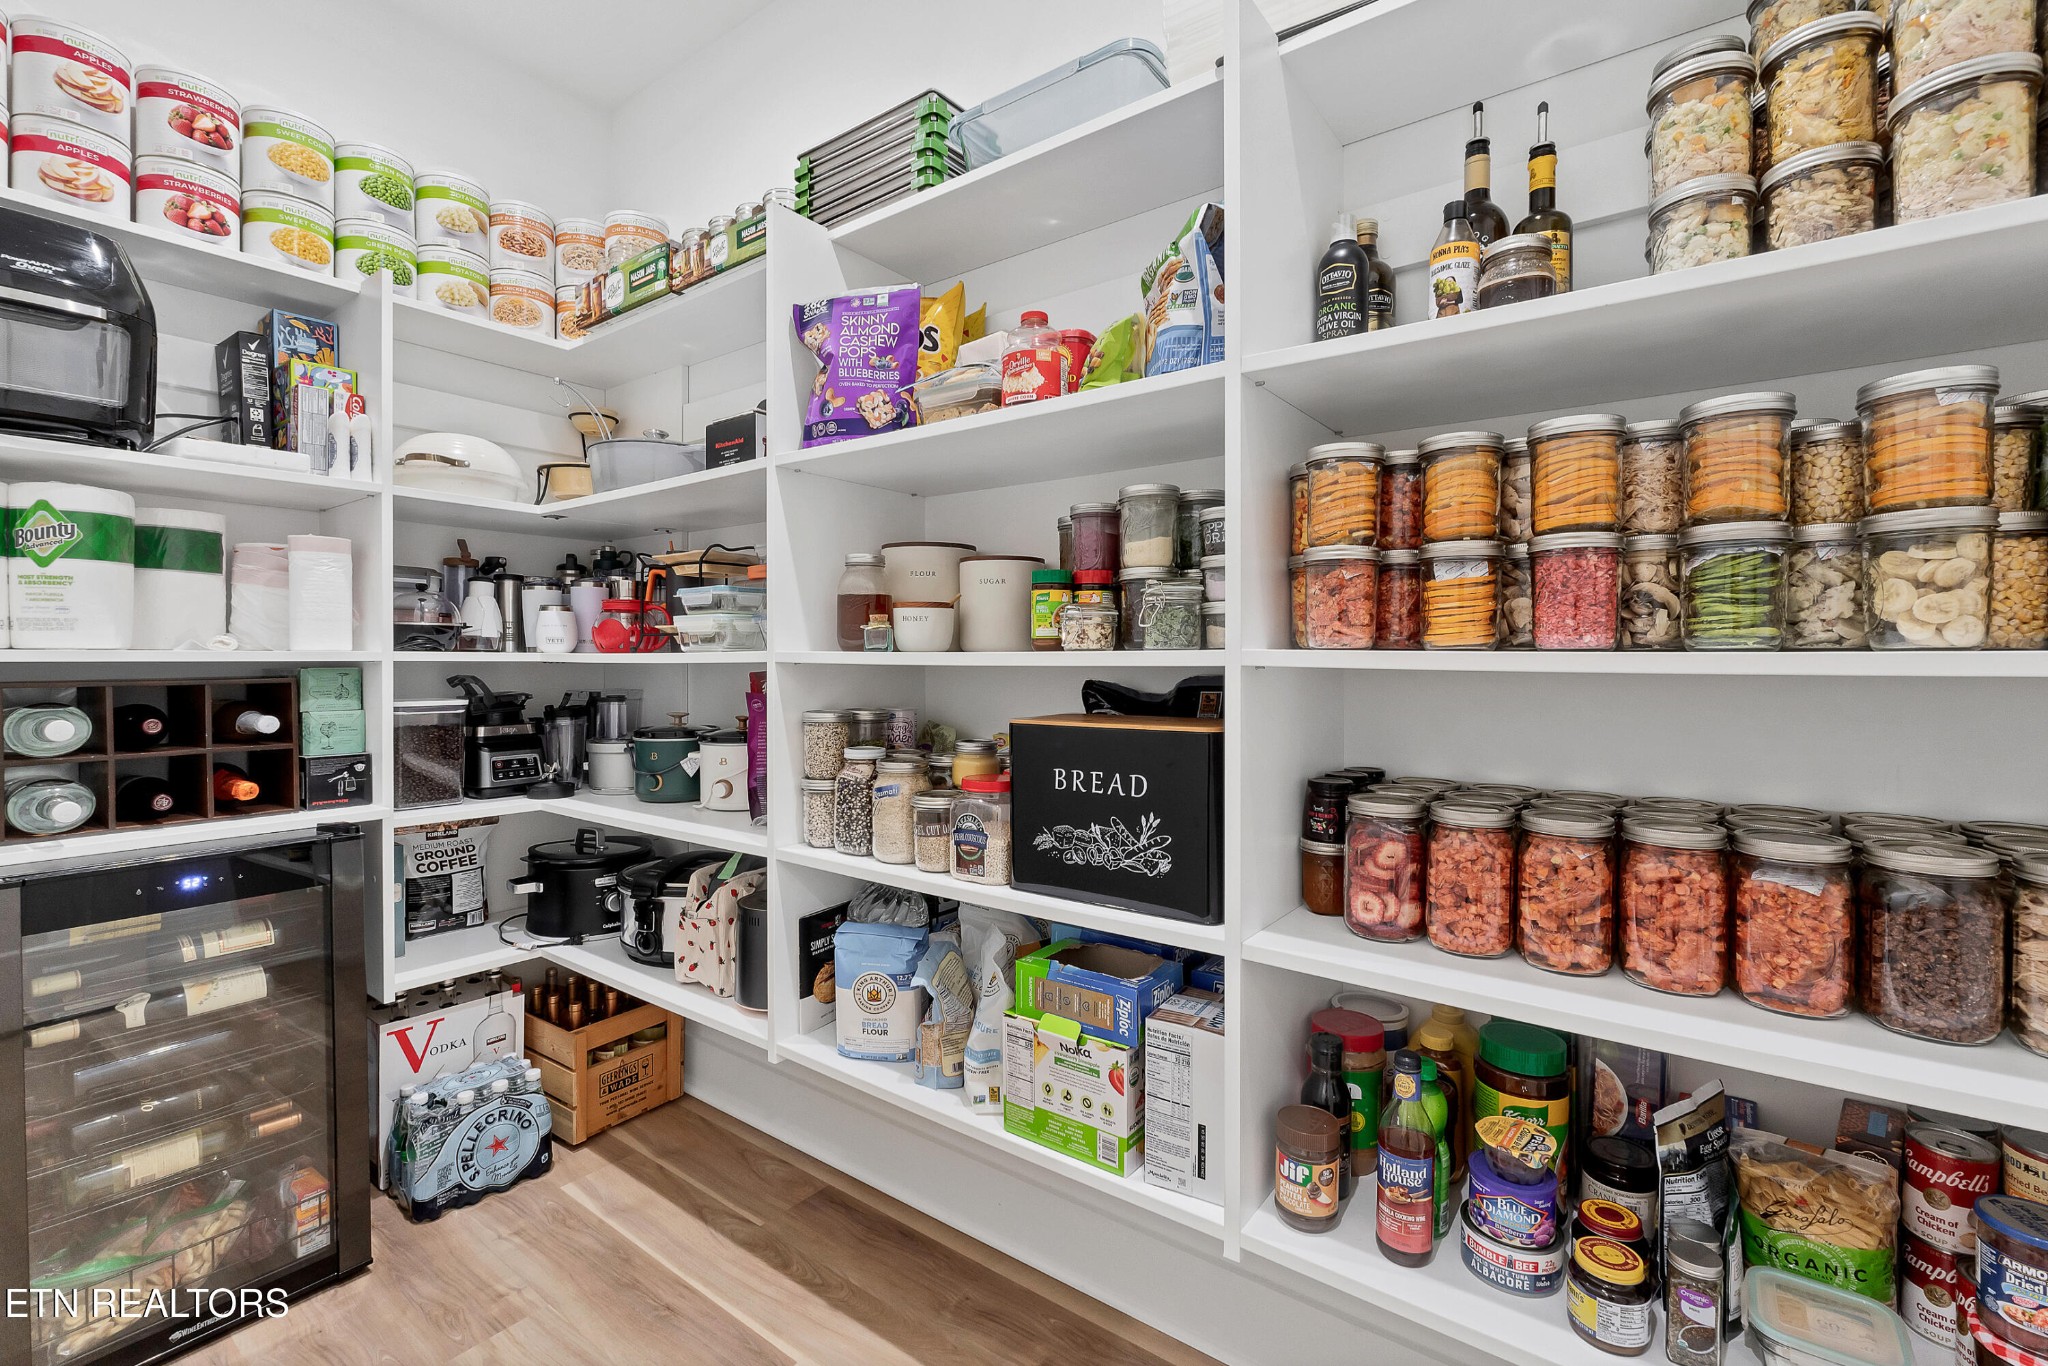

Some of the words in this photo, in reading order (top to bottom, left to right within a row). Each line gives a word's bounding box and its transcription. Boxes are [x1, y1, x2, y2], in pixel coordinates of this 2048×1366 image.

[74, 50, 113, 72] APPLES
[168, 88, 235, 120] STRAWBERRIES
[49, 131, 109, 156] nutristore
[276, 128, 306, 142] SWEET
[57, 143, 100, 161] APPLES
[175, 170, 225, 194] nutristore
[163, 179, 233, 207] STRAWBERRIES
[278, 213, 308, 227] SWEET
[1321, 269, 1353, 285] OTTAVIO
[1318, 301, 1357, 318] ORGANIC
[1333, 311, 1362, 321] VIRGIN
[841, 312, 888, 326] SKINNY
[1318, 320, 1339, 335] OLIVE
[1340, 319, 1356, 329] OIL
[839, 322, 900, 336] ALMOND
[1321, 328, 1349, 341] SPRAY
[838, 333, 899, 348] CASHEW
[241, 348, 267, 359] Degree
[838, 346, 877, 359] POPS
[838, 357, 863, 367] WITH
[1008, 356, 1031, 370] Orville
[838, 368, 900, 380] BLUEBERRIES
[14, 522, 77, 548] Bounty
[25, 538, 64, 550] Advanced
[1053, 767, 1148, 799] BREAD
[427, 830, 458, 838] KIRKLAND
[927, 825, 941, 836] CUT
[412, 842, 445, 851] MEDIUM
[446, 837, 474, 847] ROAST
[414, 844, 476, 862] GROUND
[415, 854, 478, 874] COFFEE
[182, 878, 201, 889] 52
[810, 937, 830, 952] SIMPLY
[856, 977, 869, 992] KING
[869, 976, 893, 994] ARTHUR
[1153, 982, 1175, 1007] Ziploc
[861, 1021, 889, 1029] BREAD
[1119, 997, 1132, 1039] Ziploc
[862, 1028, 889, 1036] FLOUR
[1147, 1027, 1168, 1037] Nutrition
[1147, 1032, 1160, 1041] Datos
[386, 1017, 467, 1074] VODKA
[1059, 1041, 1092, 1060] Noka
[609, 1074, 638, 1092] WADE
[1637, 1099, 1648, 1126] Barilla
[1279, 1157, 1311, 1184] Jif
[1379, 1153, 1427, 1179] Holland
[1904, 1148, 1990, 1194] Campbell's
[1279, 1179, 1304, 1194] PEANUT
[1382, 1168, 1423, 1188] House
[1665, 1175, 1696, 1186] Nutrition
[1279, 1187, 1302, 1201] BUTTER
[1279, 1194, 1310, 1211] CHOCOLATE
[1482, 1199, 1541, 1225] DIAMOND
[1497, 1197, 1528, 1216] BLUE
[1760, 1199, 1849, 1231] Garofalo
[1394, 1211, 1415, 1220] COOKING
[1493, 1217, 1532, 1230] ALMONDS
[1915, 1205, 1946, 1227] Cream
[1947, 1217, 1959, 1230] of
[1494, 1222, 1527, 1239] Blueberry
[1916, 1215, 1957, 1238] Chicken
[1920, 1229, 1949, 1246] SOUP
[1468, 1236, 1506, 1266] BUMBLE
[1515, 1261, 1536, 1271] BEE
[1753, 1234, 1869, 1283] ORGANIC
[1470, 1259, 1530, 1291] ALBACORE
[1473, 1253, 1489, 1267] SOLID
[1488, 1263, 1510, 1277] WHITE
[1511, 1272, 1529, 1281] TUNA
[2005, 1271, 2045, 1293] Dried
[1680, 1289, 1710, 1304] Organic
[1916, 1302, 1948, 1323] Cream
[1923, 1327, 1952, 1344] SOUP
